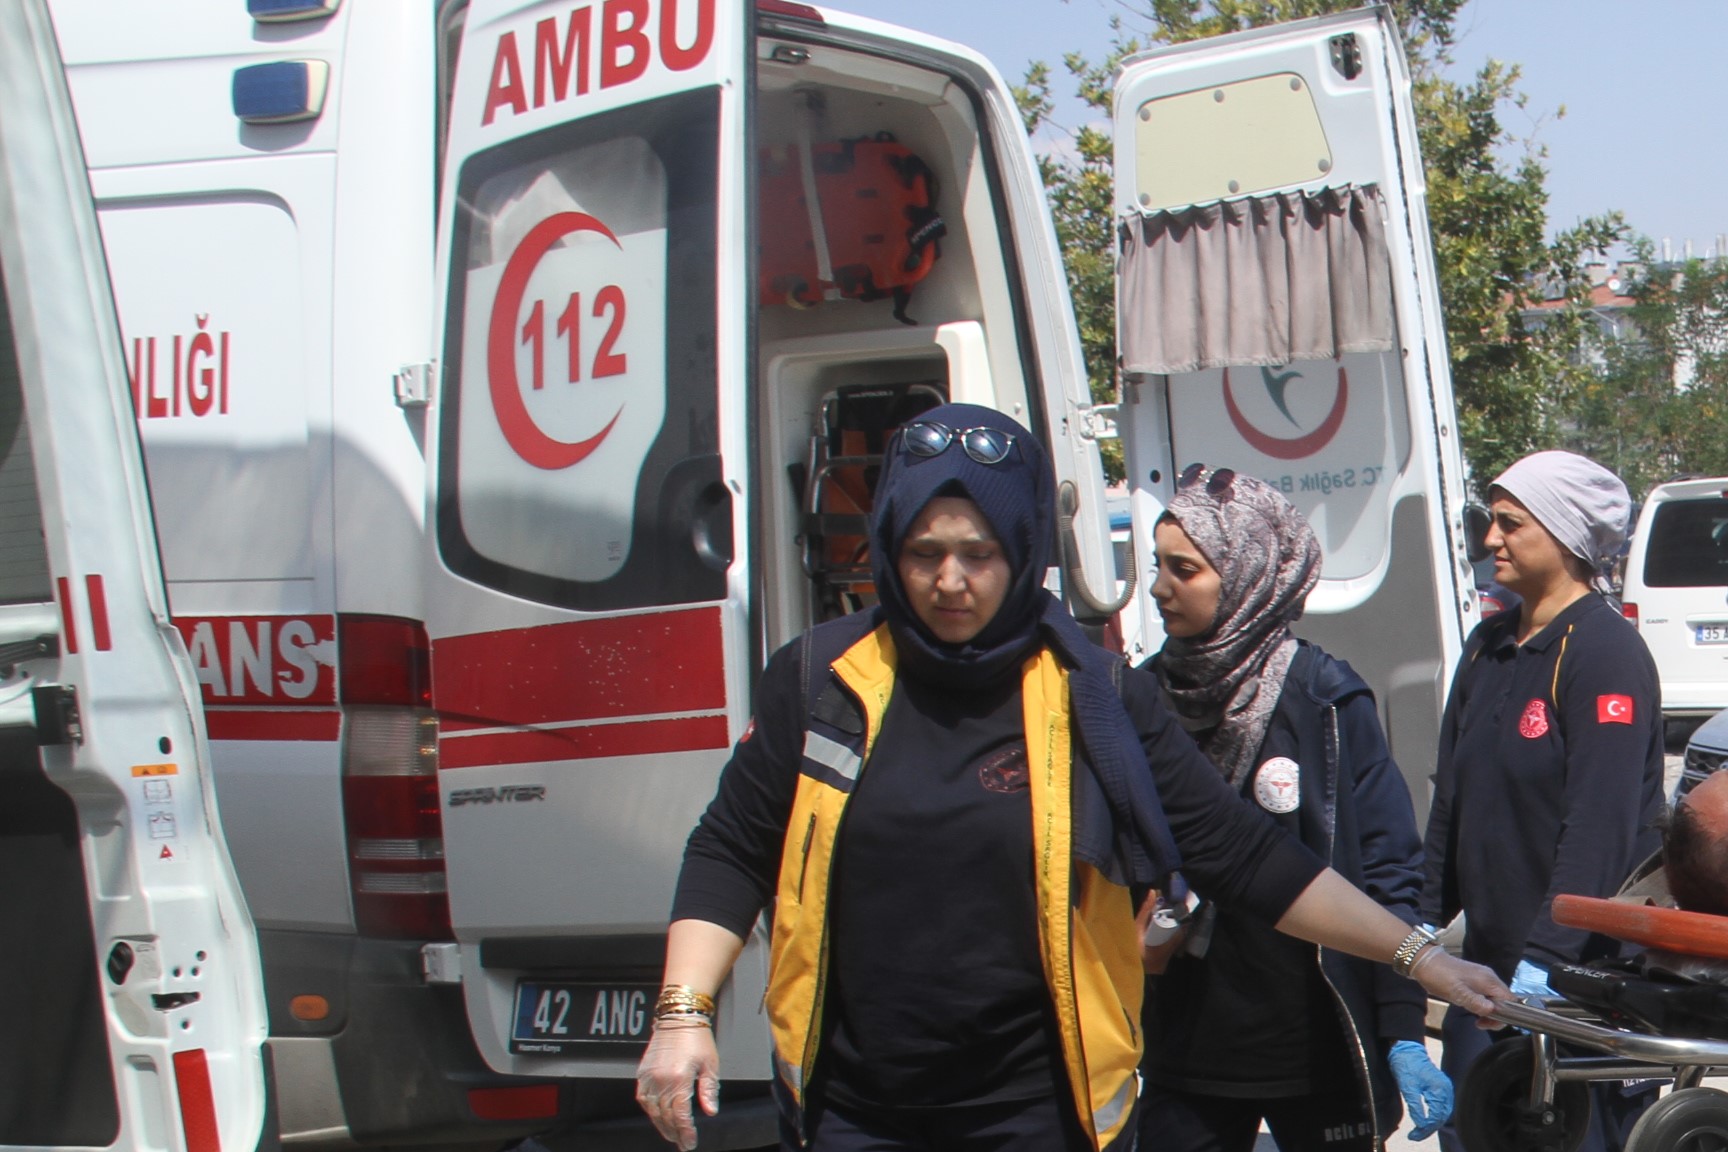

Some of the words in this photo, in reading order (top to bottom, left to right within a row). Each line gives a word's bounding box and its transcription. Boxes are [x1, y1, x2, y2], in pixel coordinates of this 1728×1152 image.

[481, 0, 716, 127] AMBU
[522, 285, 627, 390] 112
[190, 620, 318, 699] ANS
[1704, 626, 1720, 640] 35
[533, 989, 571, 1035] 42
[589, 990, 647, 1036] ANG
